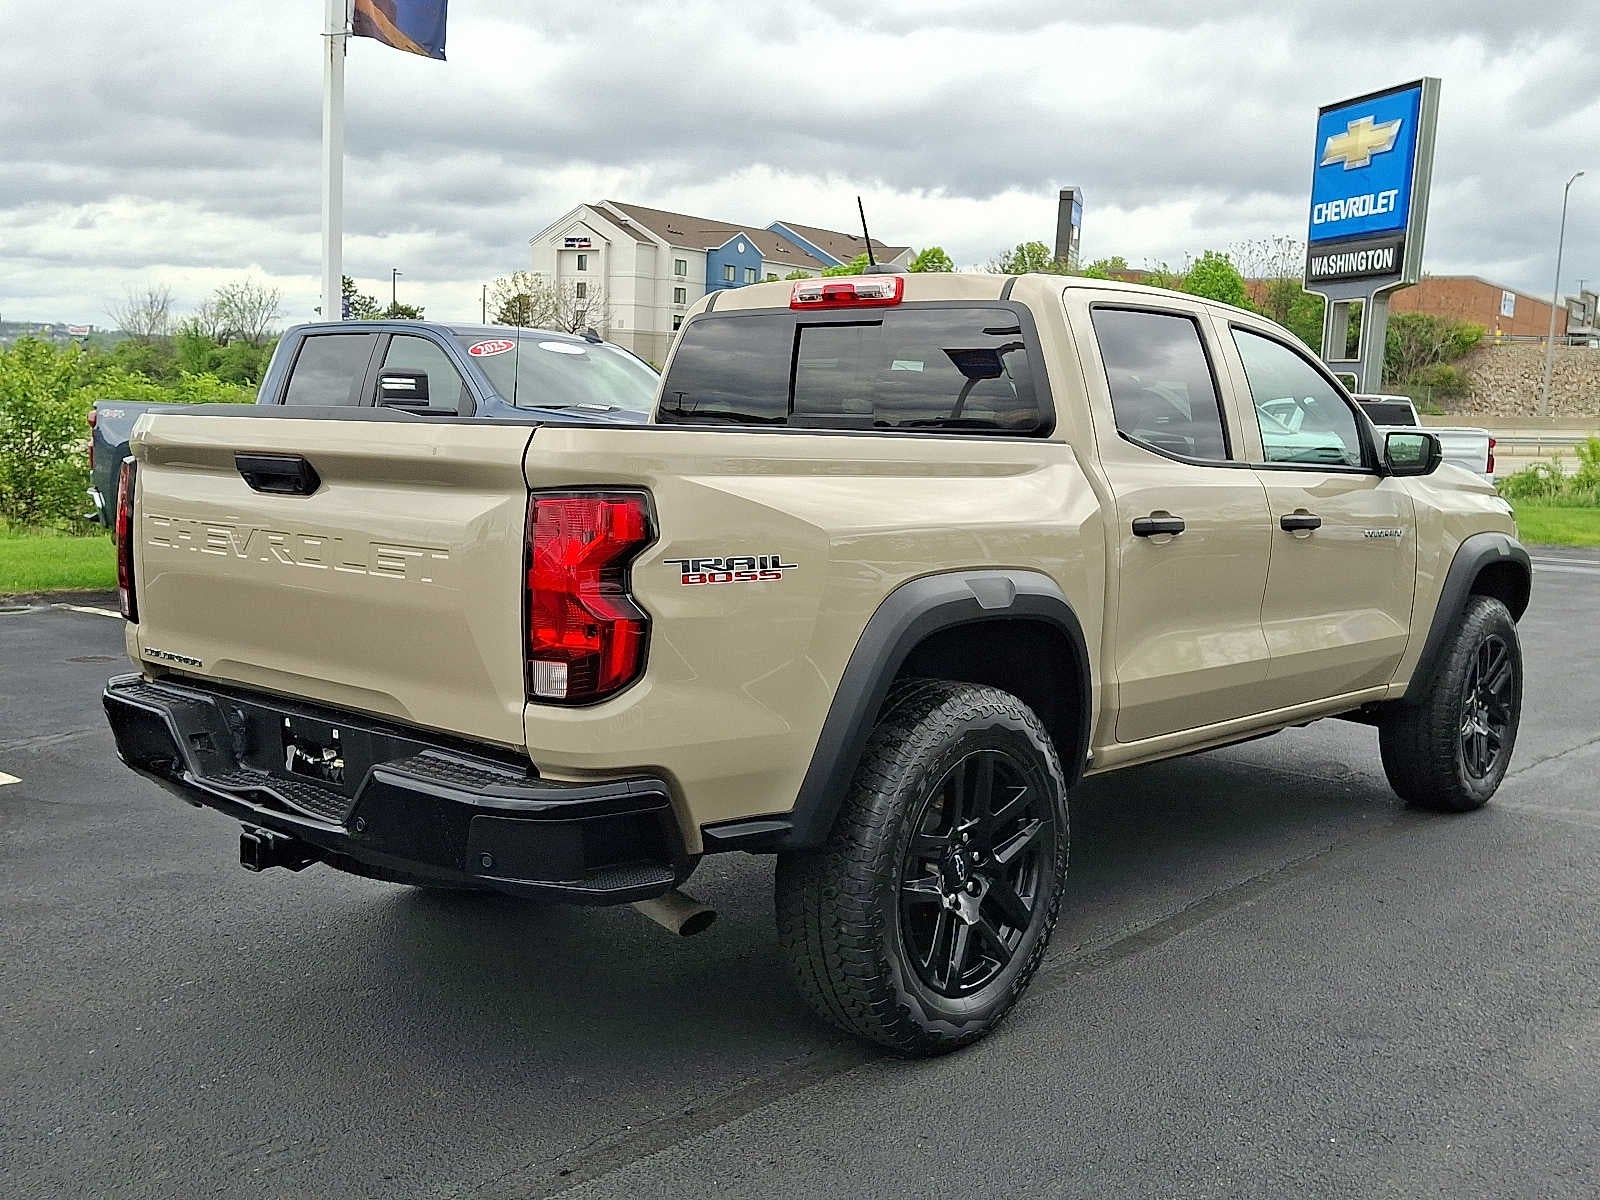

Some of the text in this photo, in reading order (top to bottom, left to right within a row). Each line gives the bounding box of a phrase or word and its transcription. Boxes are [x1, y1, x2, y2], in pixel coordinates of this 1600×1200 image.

[1313, 189, 1399, 225] CHEVROLET
[1311, 247, 1394, 276] WASHINGTON
[477, 340, 508, 354] 2025
[146, 514, 449, 583] CHEVROLET
[662, 555, 798, 574] TRAIL
[681, 569, 782, 585] BOSS
